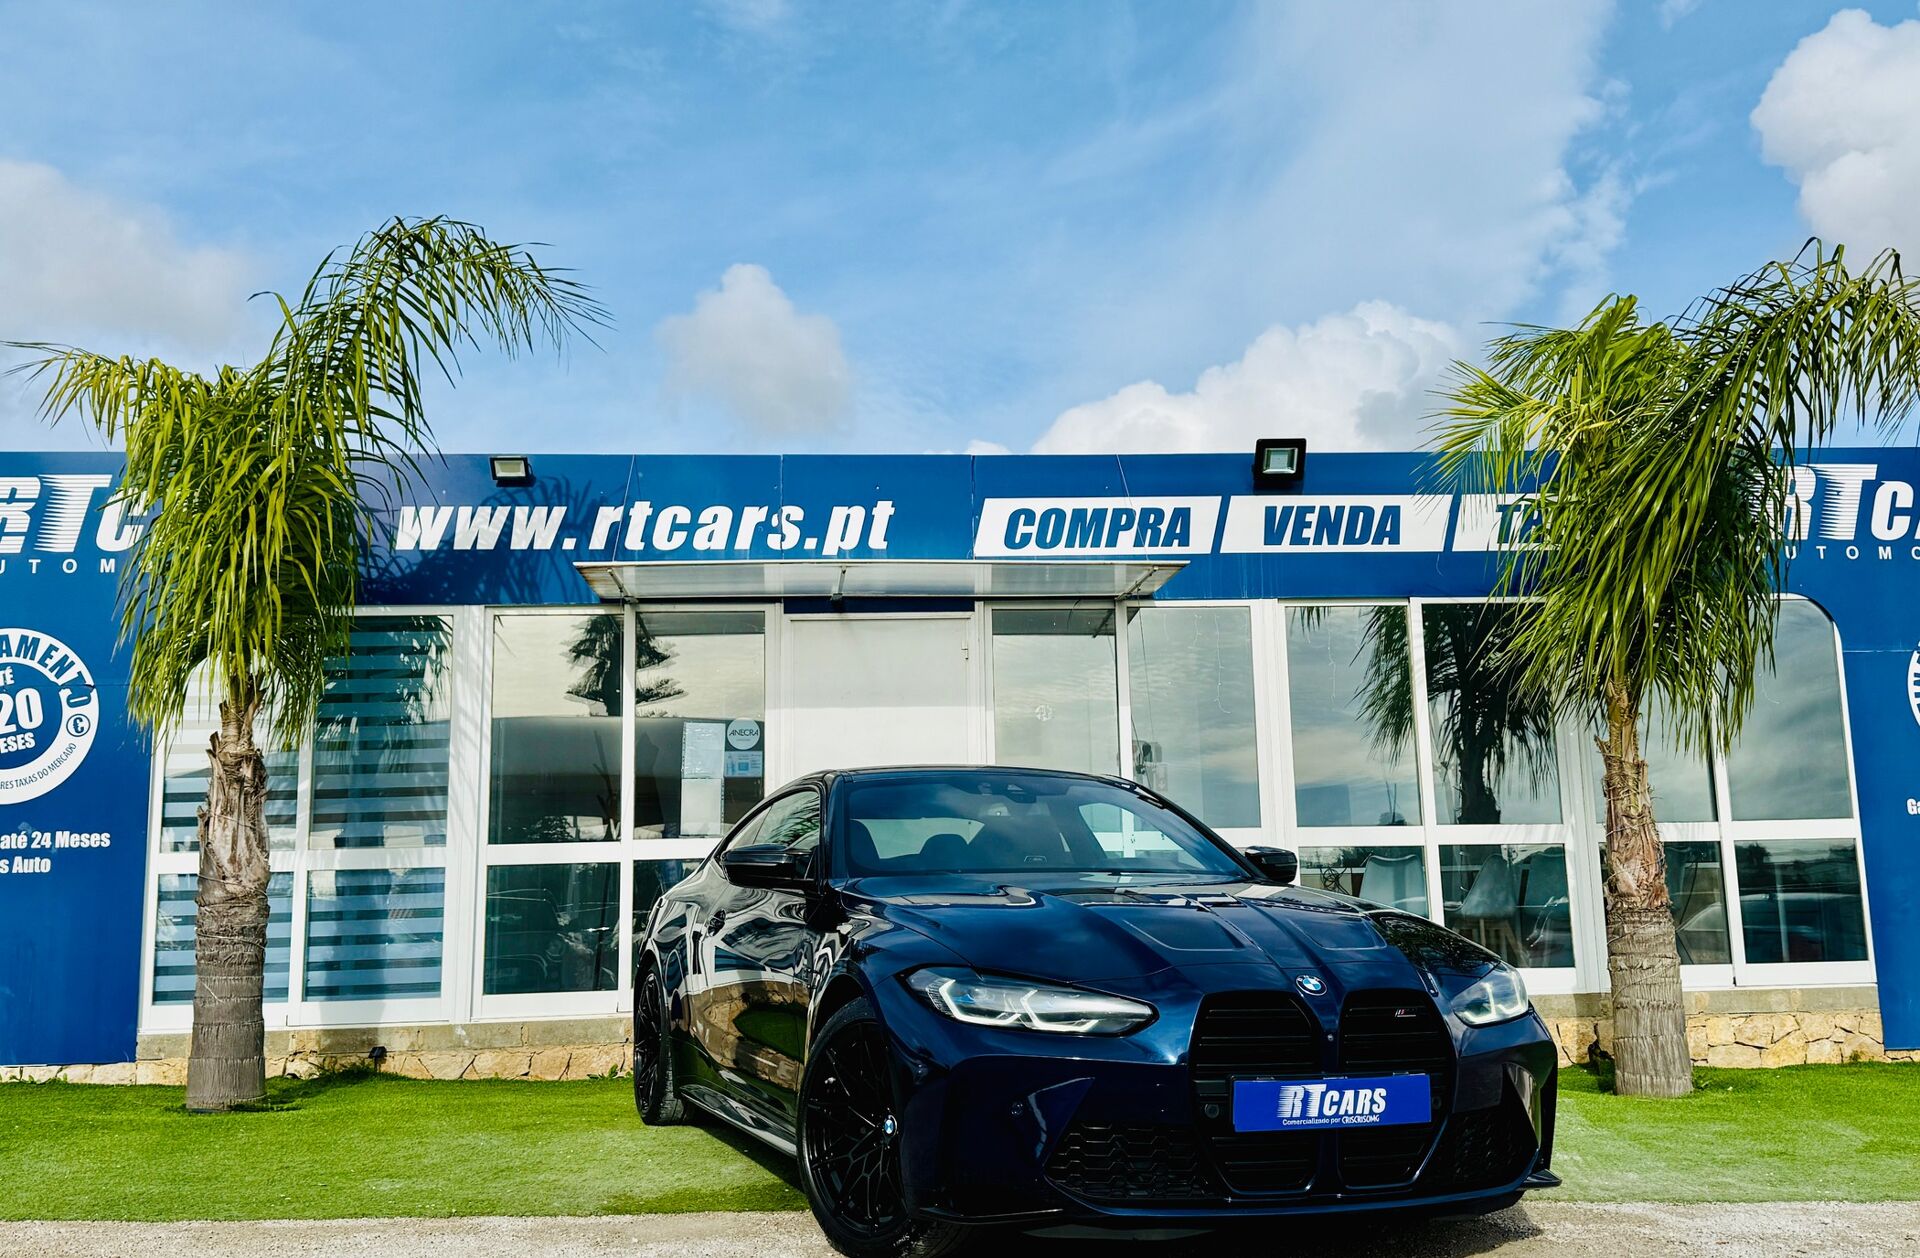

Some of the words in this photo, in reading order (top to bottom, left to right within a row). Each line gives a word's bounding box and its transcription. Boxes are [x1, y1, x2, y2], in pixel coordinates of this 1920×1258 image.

[0, 474, 148, 553] RTC
[1748, 464, 1920, 540] RTC
[396, 501, 895, 555] www.rtcars.pt
[1004, 507, 1191, 549] COMPRA
[1264, 505, 1401, 546] VENDA
[1755, 545, 1920, 560] UTOMO
[0, 732, 36, 753] ESES
[15, 773, 38, 788] TAXAS
[38, 768, 50, 780] DO
[48, 742, 77, 773] MERCADO
[0, 831, 28, 849] até
[30, 831, 52, 849] 24
[55, 830, 111, 848] Meses
[12, 856, 51, 874] Auto
[1282, 1117, 1330, 1126] Comercializado
[1331, 1117, 1341, 1125] por
